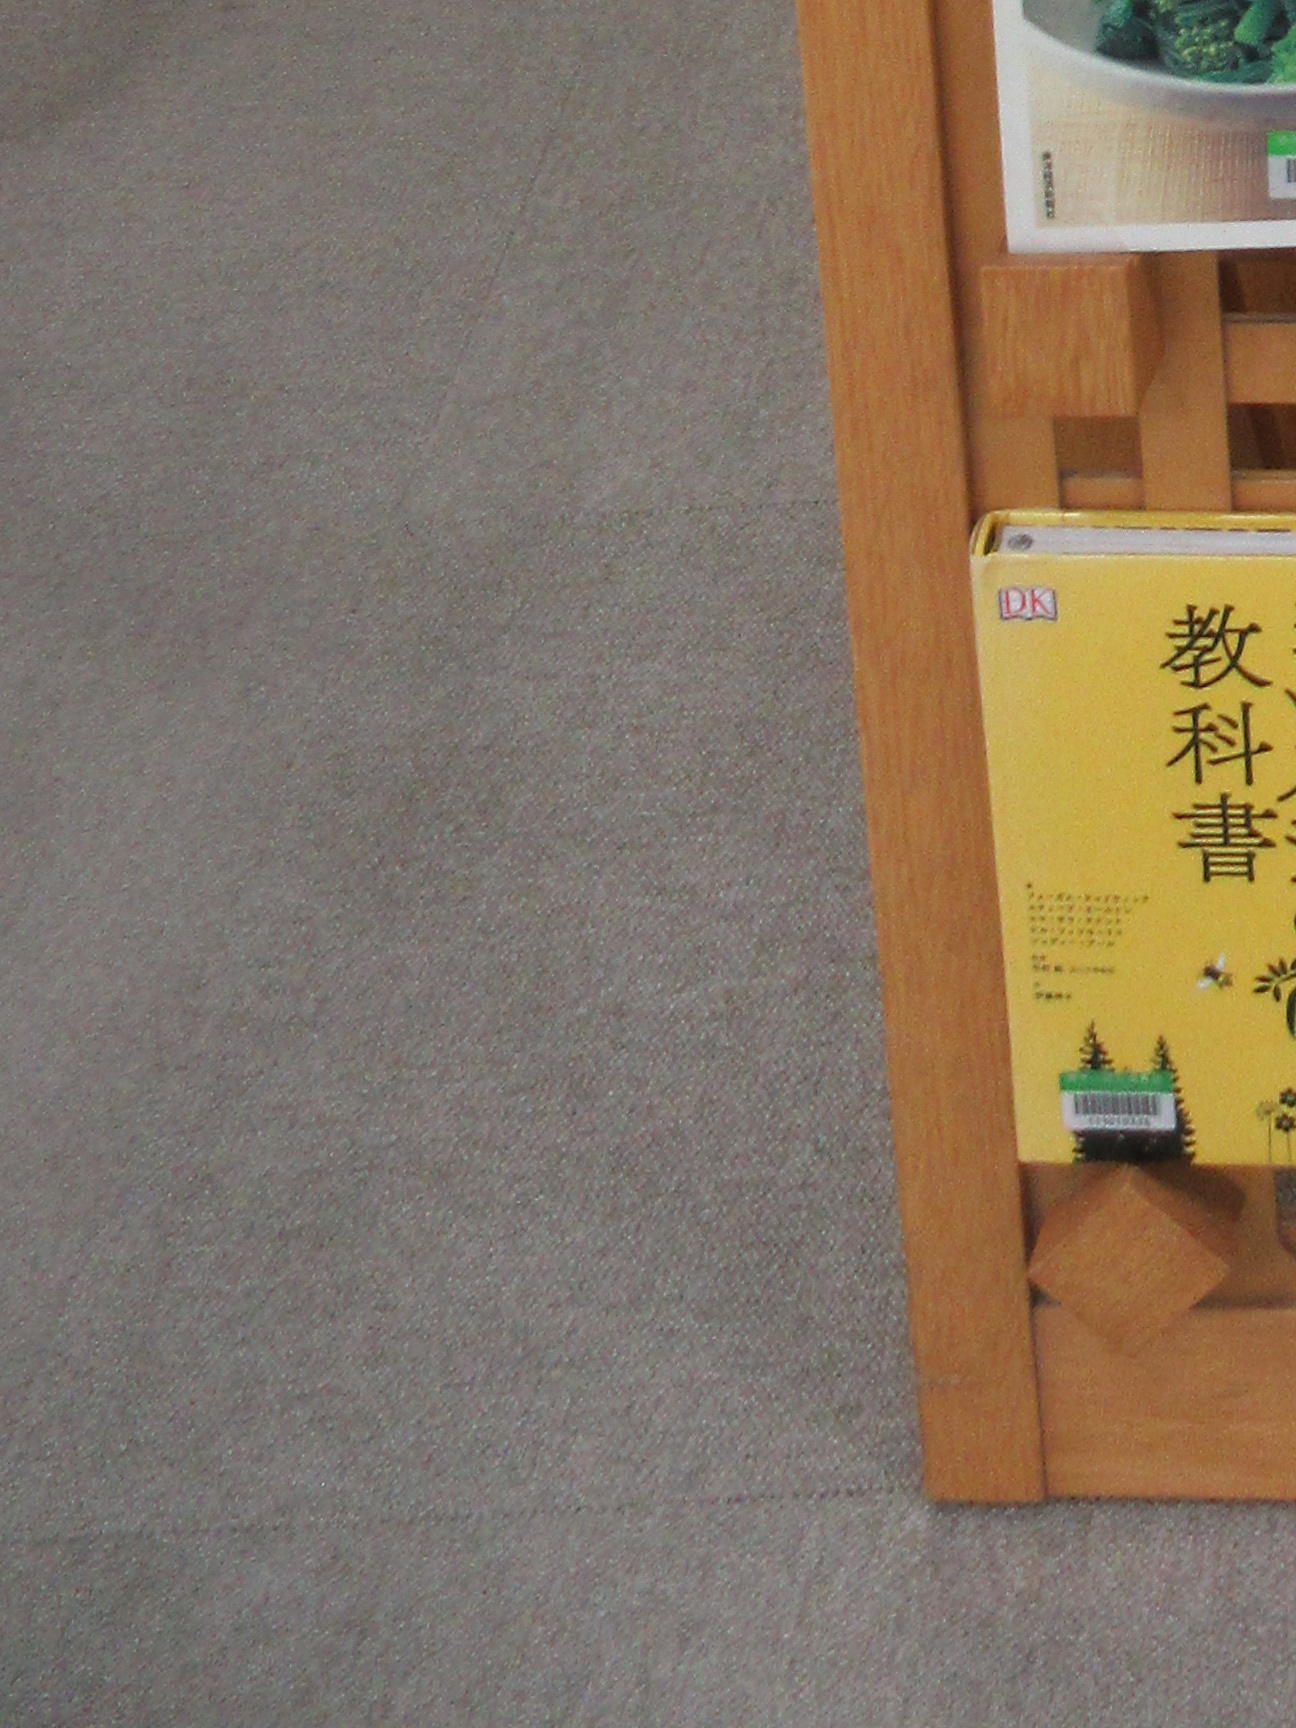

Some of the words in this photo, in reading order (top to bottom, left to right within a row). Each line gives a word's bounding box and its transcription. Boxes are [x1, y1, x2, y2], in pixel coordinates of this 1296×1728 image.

[1004, 589, 1053, 617] DK
[1160, 602, 1278, 884] 教科書
